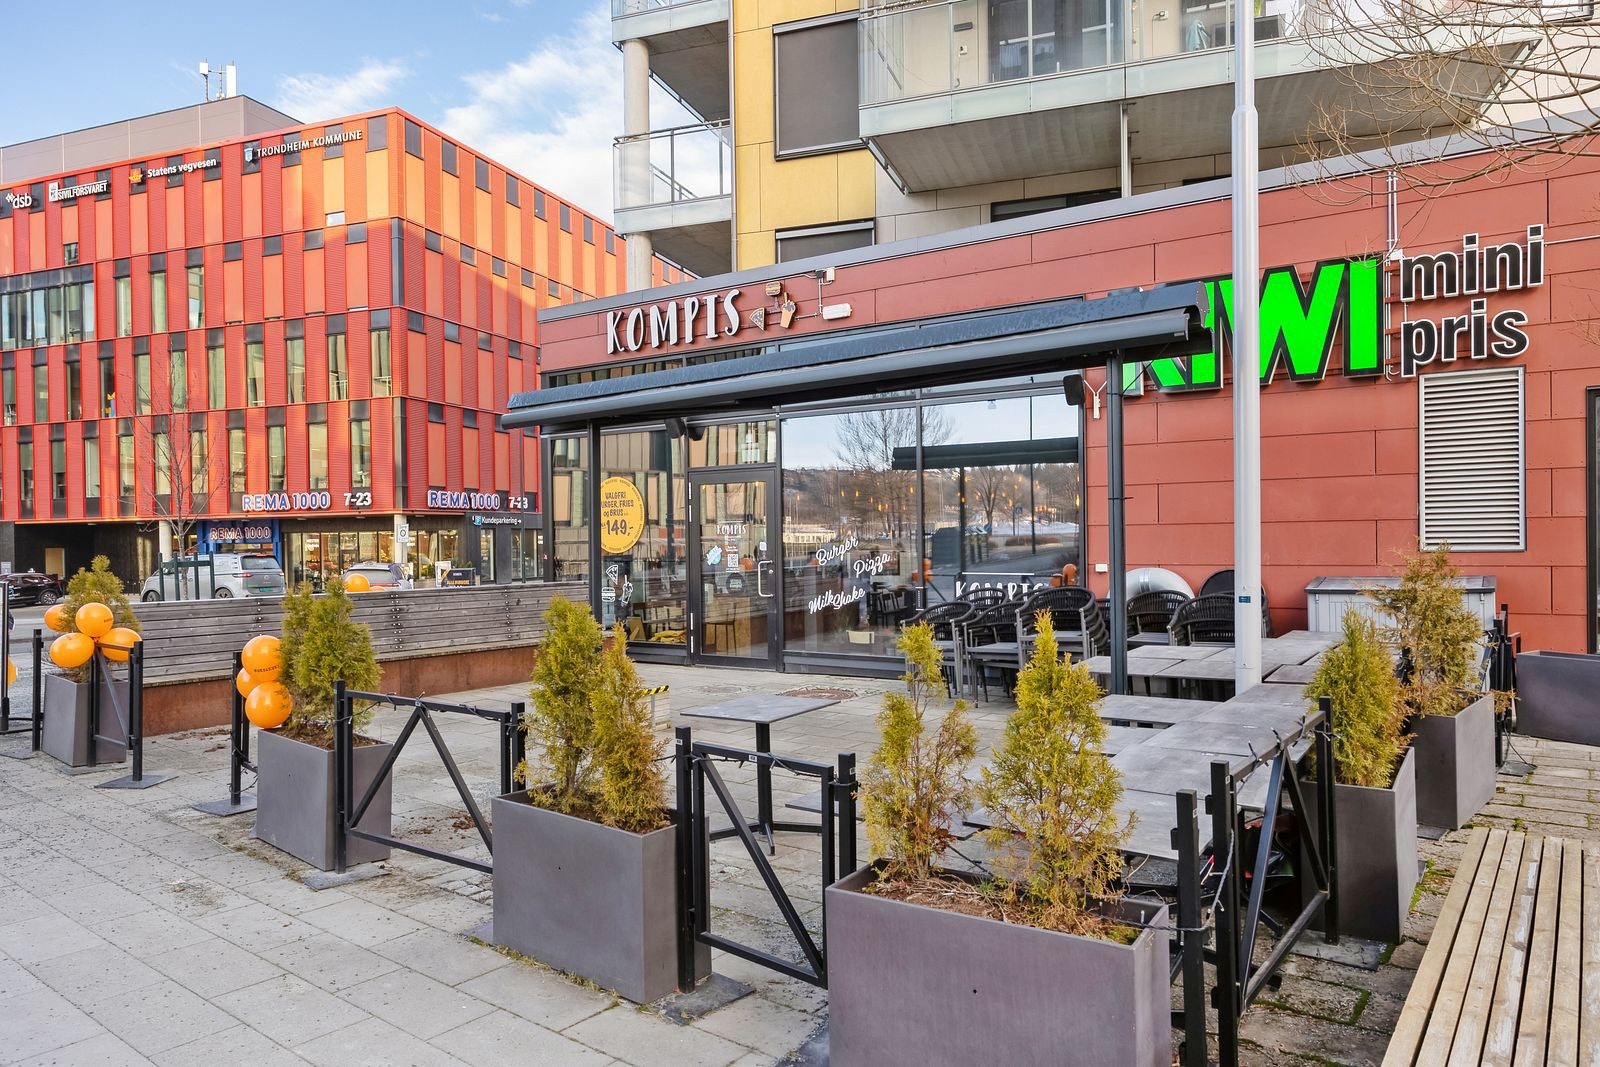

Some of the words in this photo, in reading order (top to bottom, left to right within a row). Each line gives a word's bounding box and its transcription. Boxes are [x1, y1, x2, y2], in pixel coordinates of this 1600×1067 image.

[257, 139, 310, 158] TRONDHEIM
[313, 130, 362, 148] KOMMUNE
[147, 166, 176, 178] Statens
[179, 158, 217, 172] vegvesen
[12, 192, 33, 209] dsb
[57, 182, 108, 200] SIVILFORSVARET
[1400, 223, 1545, 303] mini
[606, 288, 741, 355] KOMPIS
[1400, 298, 1531, 379] pris
[241, 492, 290, 512] REMA
[292, 491, 331, 510] 1000
[343, 492, 373, 506] 7-23
[427, 490, 470, 509] REMA
[470, 492, 501, 510] 1000
[605, 491, 627, 500] VALGFRI
[619, 499, 634, 508] FRIES
[481, 516, 518, 526] Kundeparkering
[610, 508, 624, 517] BRUS
[209, 526, 242, 541] REMA
[243, 526, 272, 540] 1000
[716, 524, 747, 535] KOMPIS
[815, 535, 859, 566] Burger
[853, 553, 891, 579] Pizza
